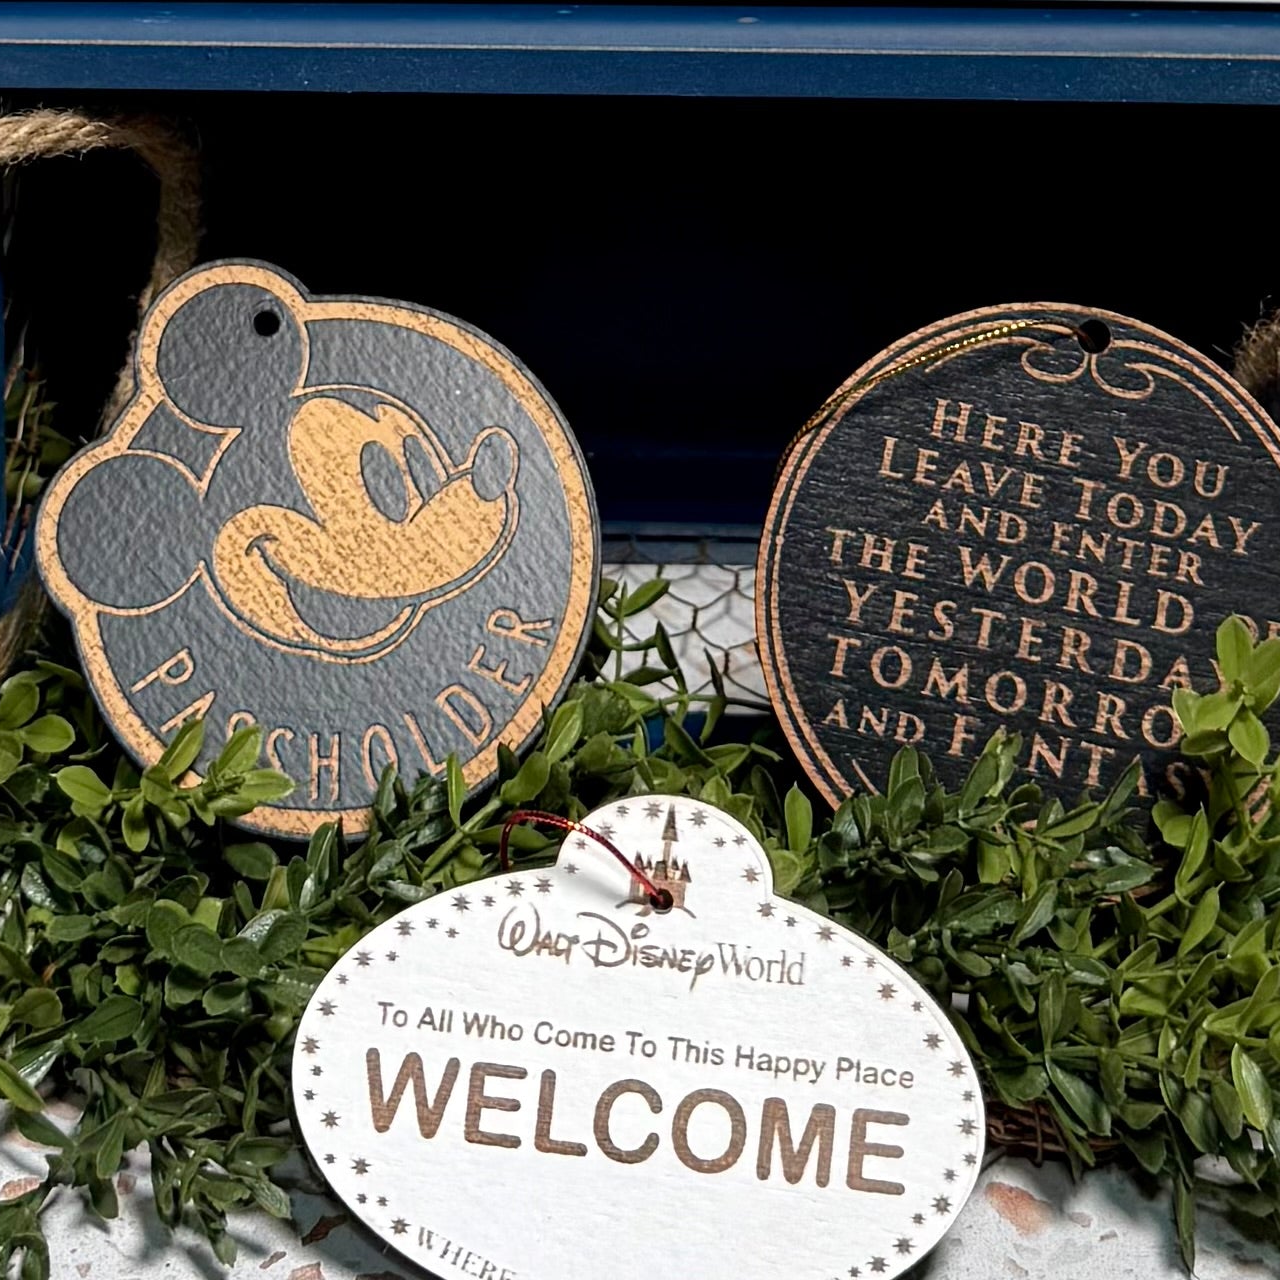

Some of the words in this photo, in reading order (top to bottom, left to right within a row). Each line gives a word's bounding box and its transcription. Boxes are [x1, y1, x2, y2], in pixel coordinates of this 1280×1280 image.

[878, 436, 1045, 510] LEAVE
[1072, 476, 1263, 556] TODAY
[929, 398, 1084, 469] HERE
[1113, 436, 1231, 499] YOU
[823, 527, 928, 580] THE
[956, 546, 1196, 636] WORLD
[921, 498, 1029, 546] AND
[1050, 521, 1208, 587] ENTER
[821, 697, 927, 744] AND
[825, 634, 1184, 750] TOMORRO
[717, 941, 808, 988] World
[376, 1001, 410, 1030] To
[417, 1006, 454, 1038] All
[462, 1012, 525, 1043] Who
[533, 1020, 617, 1054] Come
[625, 1031, 659, 1059] To
[668, 1036, 726, 1068] This
[734, 1044, 828, 1085] Happy
[835, 1056, 915, 1090] Place
[365, 1046, 912, 1198] WELCOME
